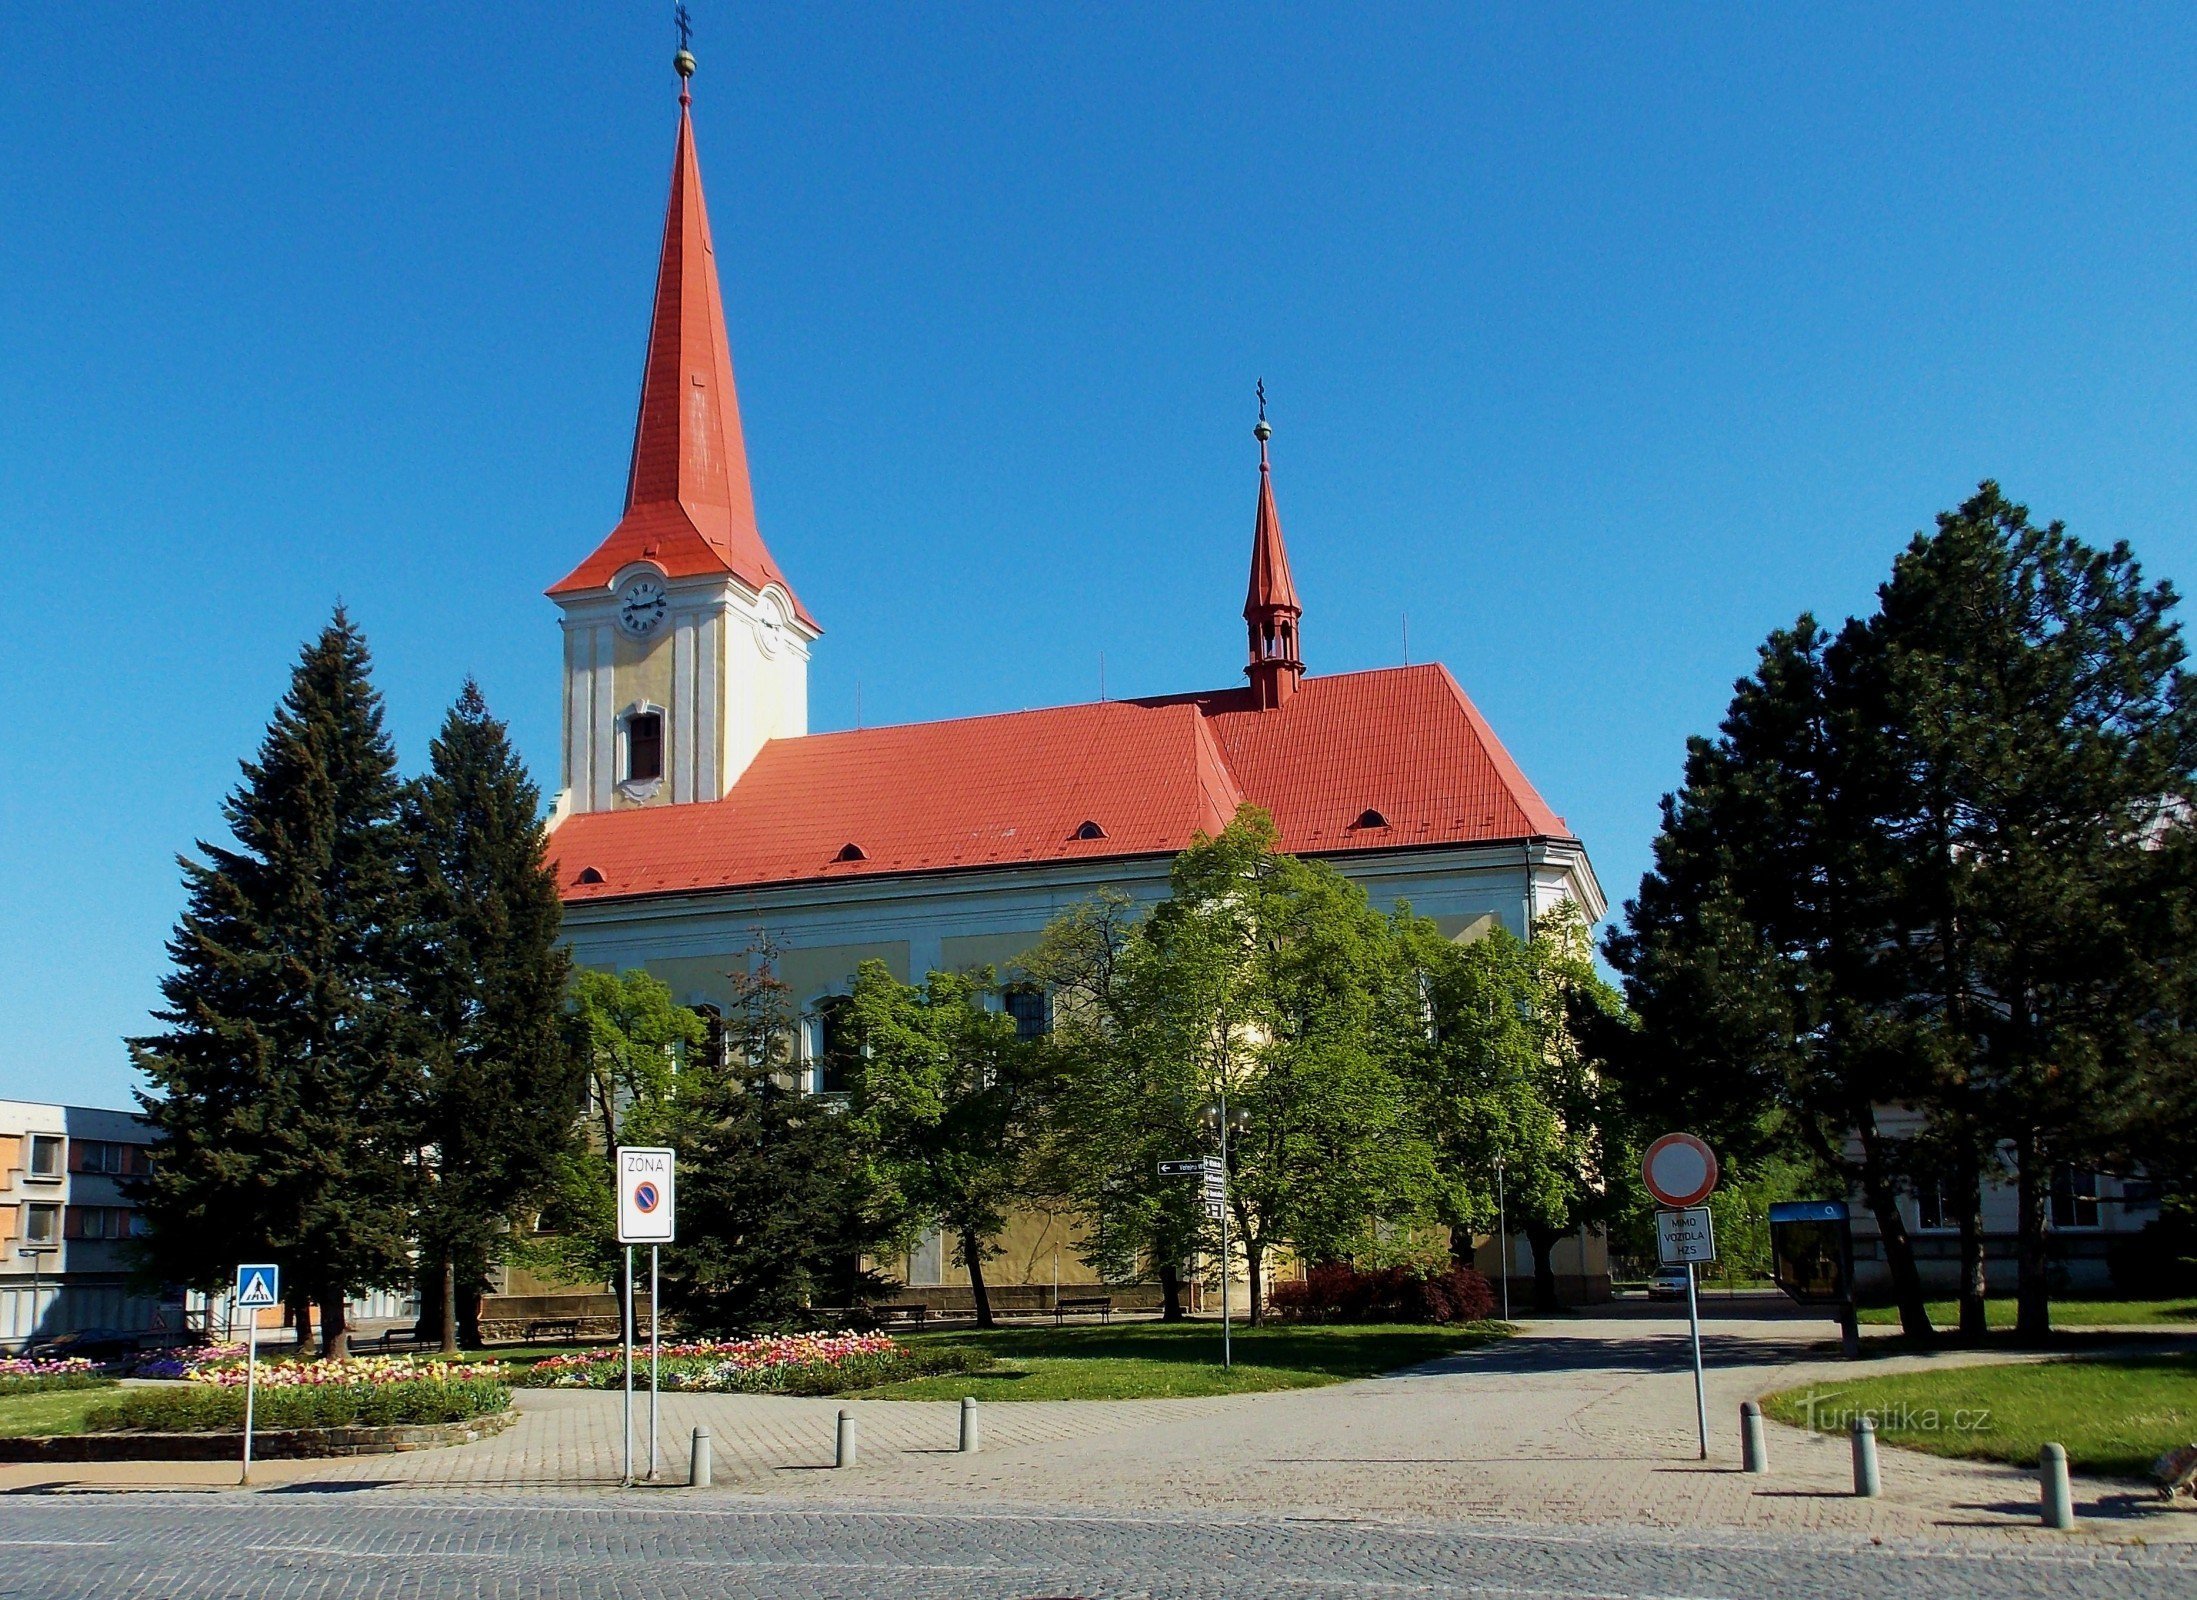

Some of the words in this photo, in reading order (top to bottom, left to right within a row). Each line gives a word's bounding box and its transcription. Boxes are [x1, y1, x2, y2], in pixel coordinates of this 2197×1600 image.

[628, 1154, 664, 1172] ZÓNA
[1672, 1218, 1697, 1228] MIMO
[1664, 1231, 1704, 1242] VOZIDLA
[1677, 1246, 1697, 1255] HZS
